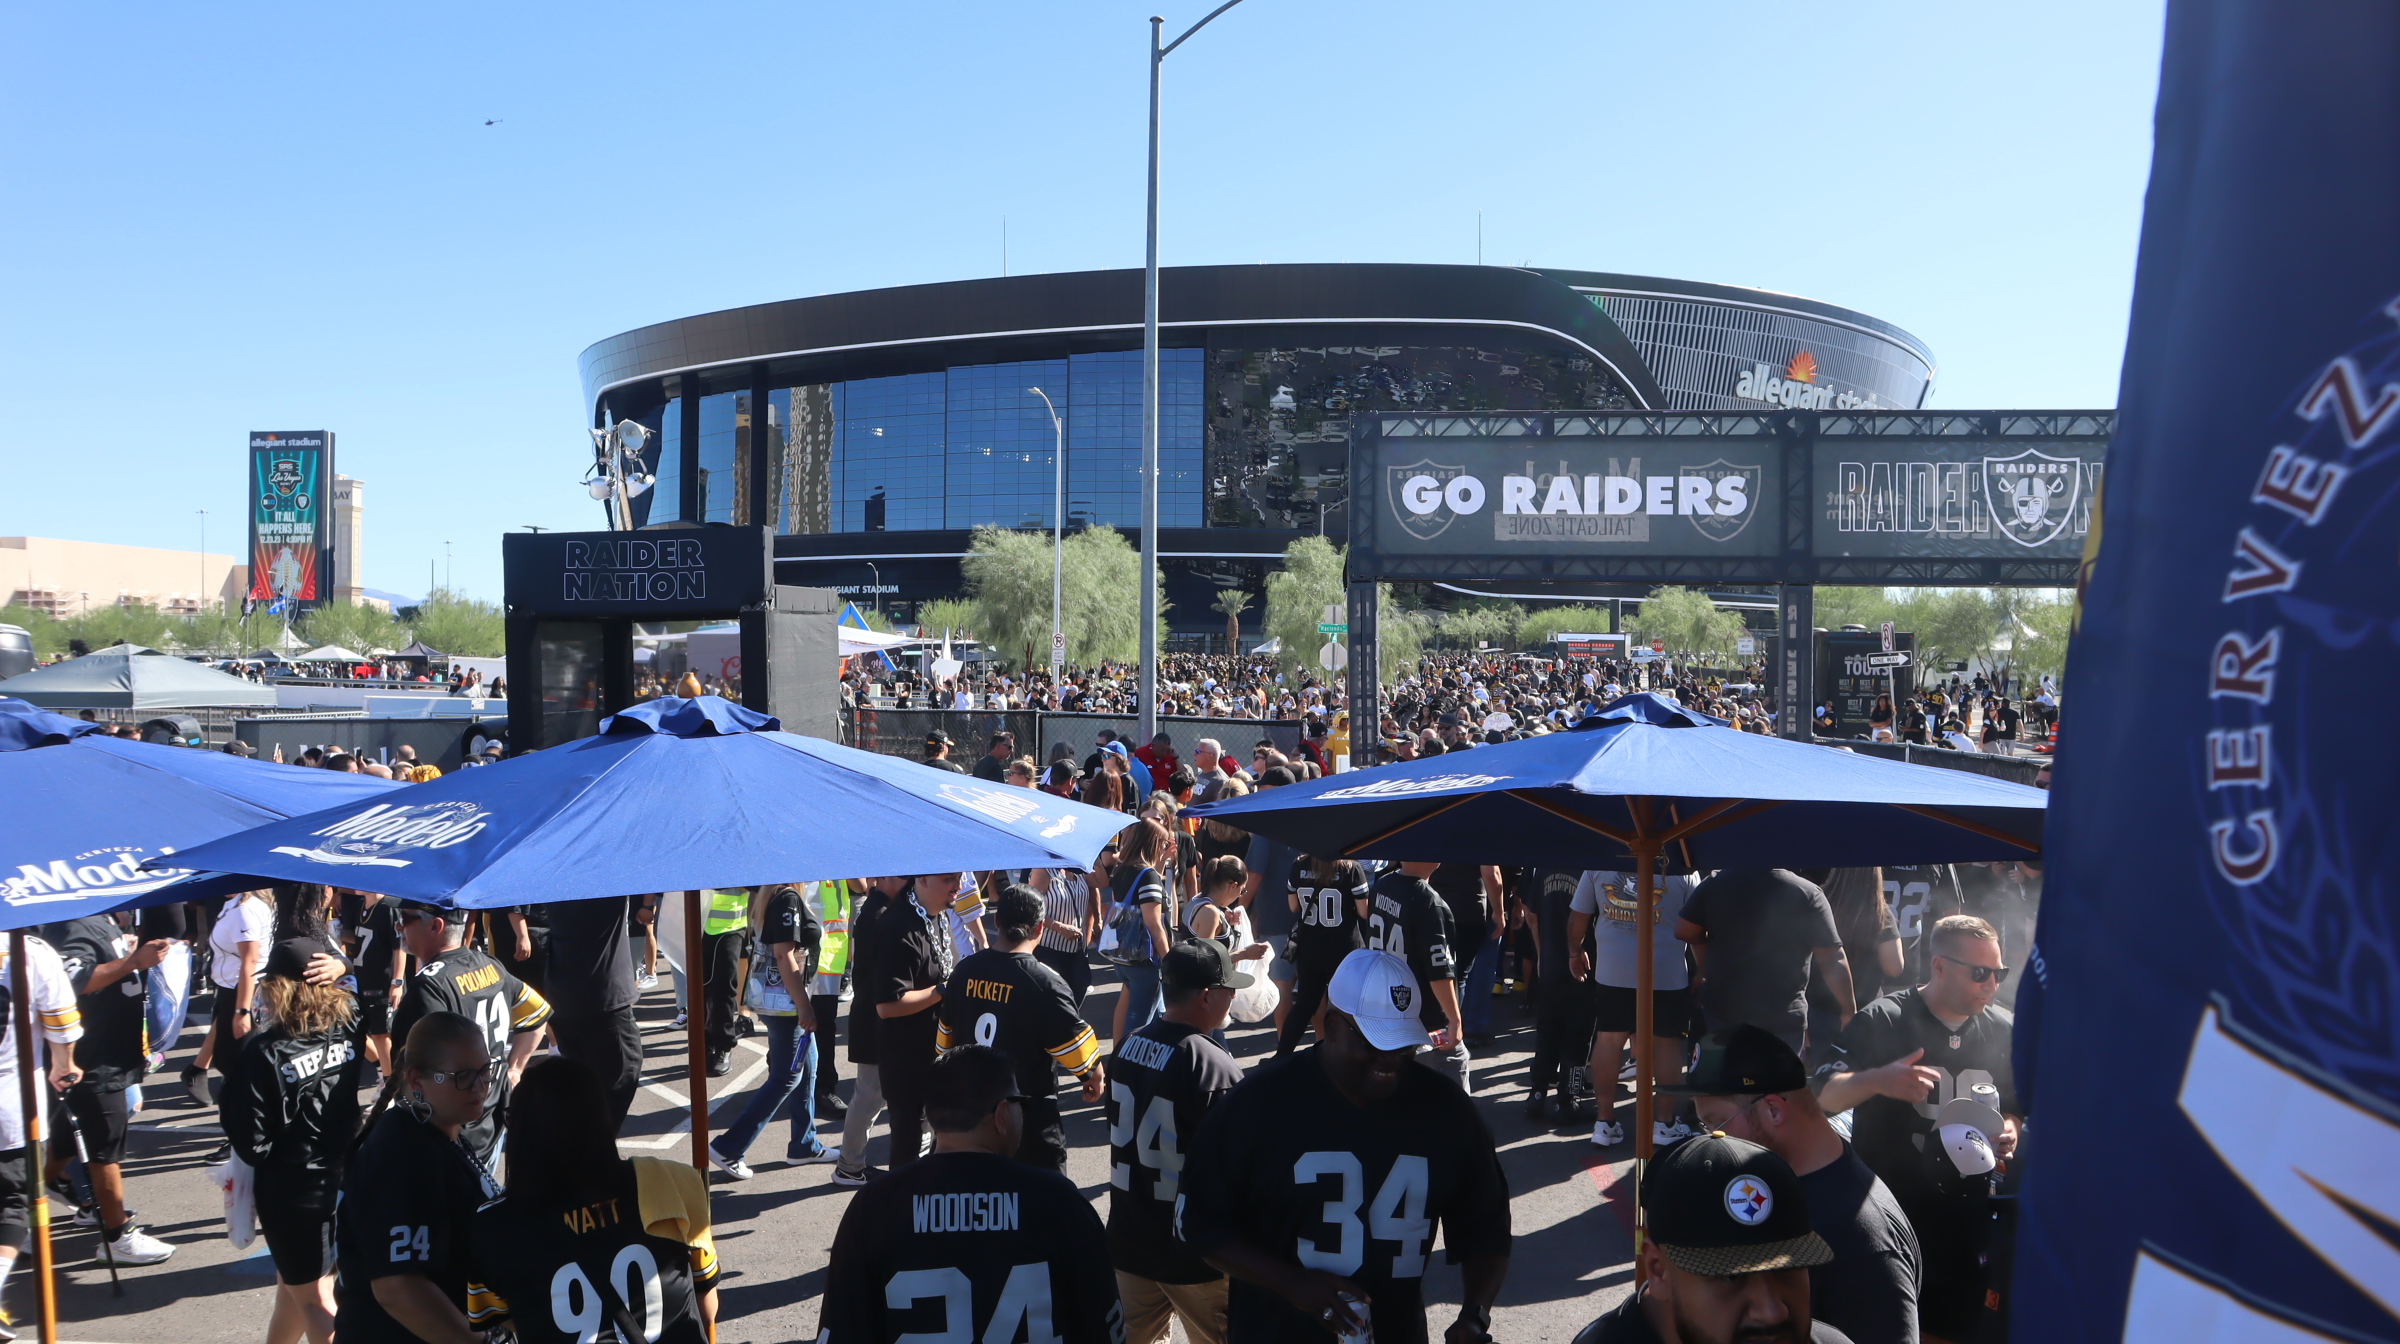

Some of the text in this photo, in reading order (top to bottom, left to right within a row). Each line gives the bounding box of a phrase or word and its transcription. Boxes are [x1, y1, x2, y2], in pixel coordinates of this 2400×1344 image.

[1736, 363, 1836, 409] allegiant
[251, 437, 321, 448] allegiant stadium
[1995, 463, 2069, 475] RAIDERS
[1402, 474, 1748, 516] GO RAIDERS
[1838, 461, 1990, 533] RAIDER
[259, 523, 292, 534] HAPPENS
[275, 511, 295, 522] IT ALL
[566, 539, 704, 569] RAIDER
[564, 571, 706, 600] NATION
[862, 585, 899, 593] STADIUM
[2207, 295, 2400, 887] CERVEZ
[1126, 694, 1137, 706] 24
[423, 801, 480, 813] CERVEZA
[309, 803, 493, 849] Modelo
[75, 846, 144, 860] CERVEZA
[1544, 880, 1578, 896] CHAMPIO
[782, 912, 800, 927] 34
[1603, 903, 1665, 923] SOLIDAY
[1369, 913, 1408, 966] 24
[966, 978, 1014, 1004] PICKETT
[281, 1040, 356, 1084] STEELERS
[1118, 1035, 1175, 1072] WOODSON
[1111, 1078, 1186, 1202] 24
[913, 1192, 1019, 1233] WOODSON
[1294, 1151, 1431, 1279] 34
[390, 1225, 431, 1263] 24
[550, 1243, 664, 1344] 90
[885, 1261, 1063, 1344] 24
